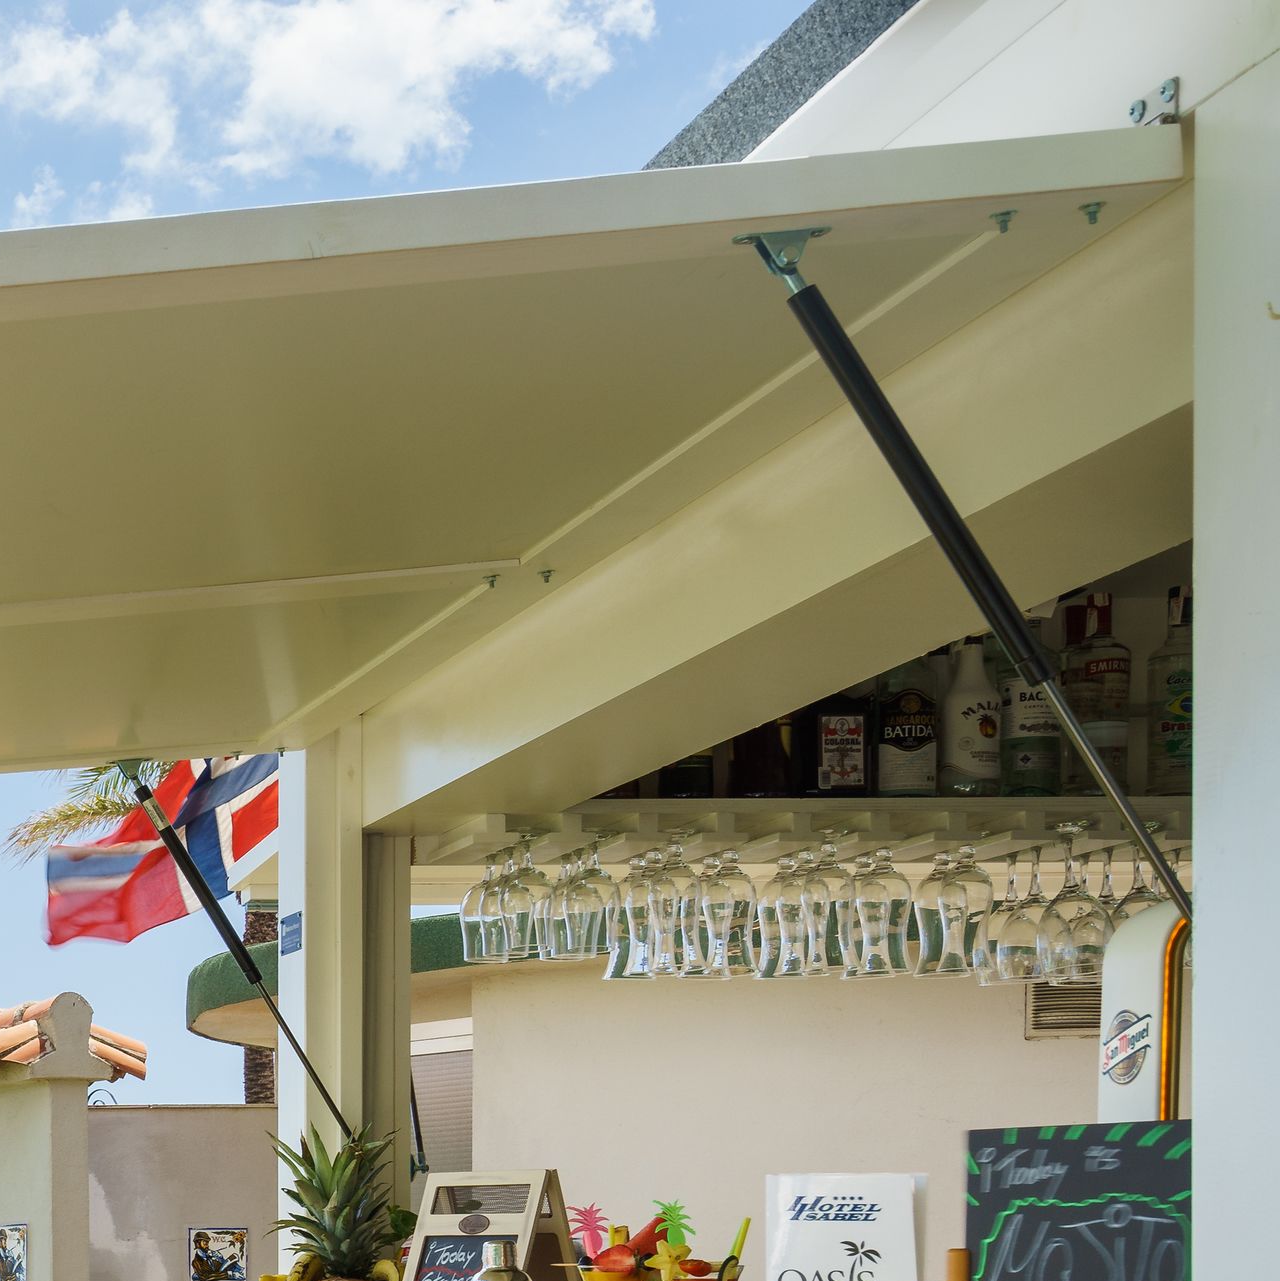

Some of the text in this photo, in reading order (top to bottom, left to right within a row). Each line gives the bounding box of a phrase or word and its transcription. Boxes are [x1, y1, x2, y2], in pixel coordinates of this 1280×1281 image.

[1019, 691, 1047, 702] BAC
[961, 701, 1001, 720] MALI
[884, 725, 934, 738] BATIDA
[824, 738, 861, 746] COLOSAL
[1118, 1022, 1149, 1054] Miguel
[786, 1195, 882, 1212] HOTEL
[790, 1203, 878, 1221] ISABEL
